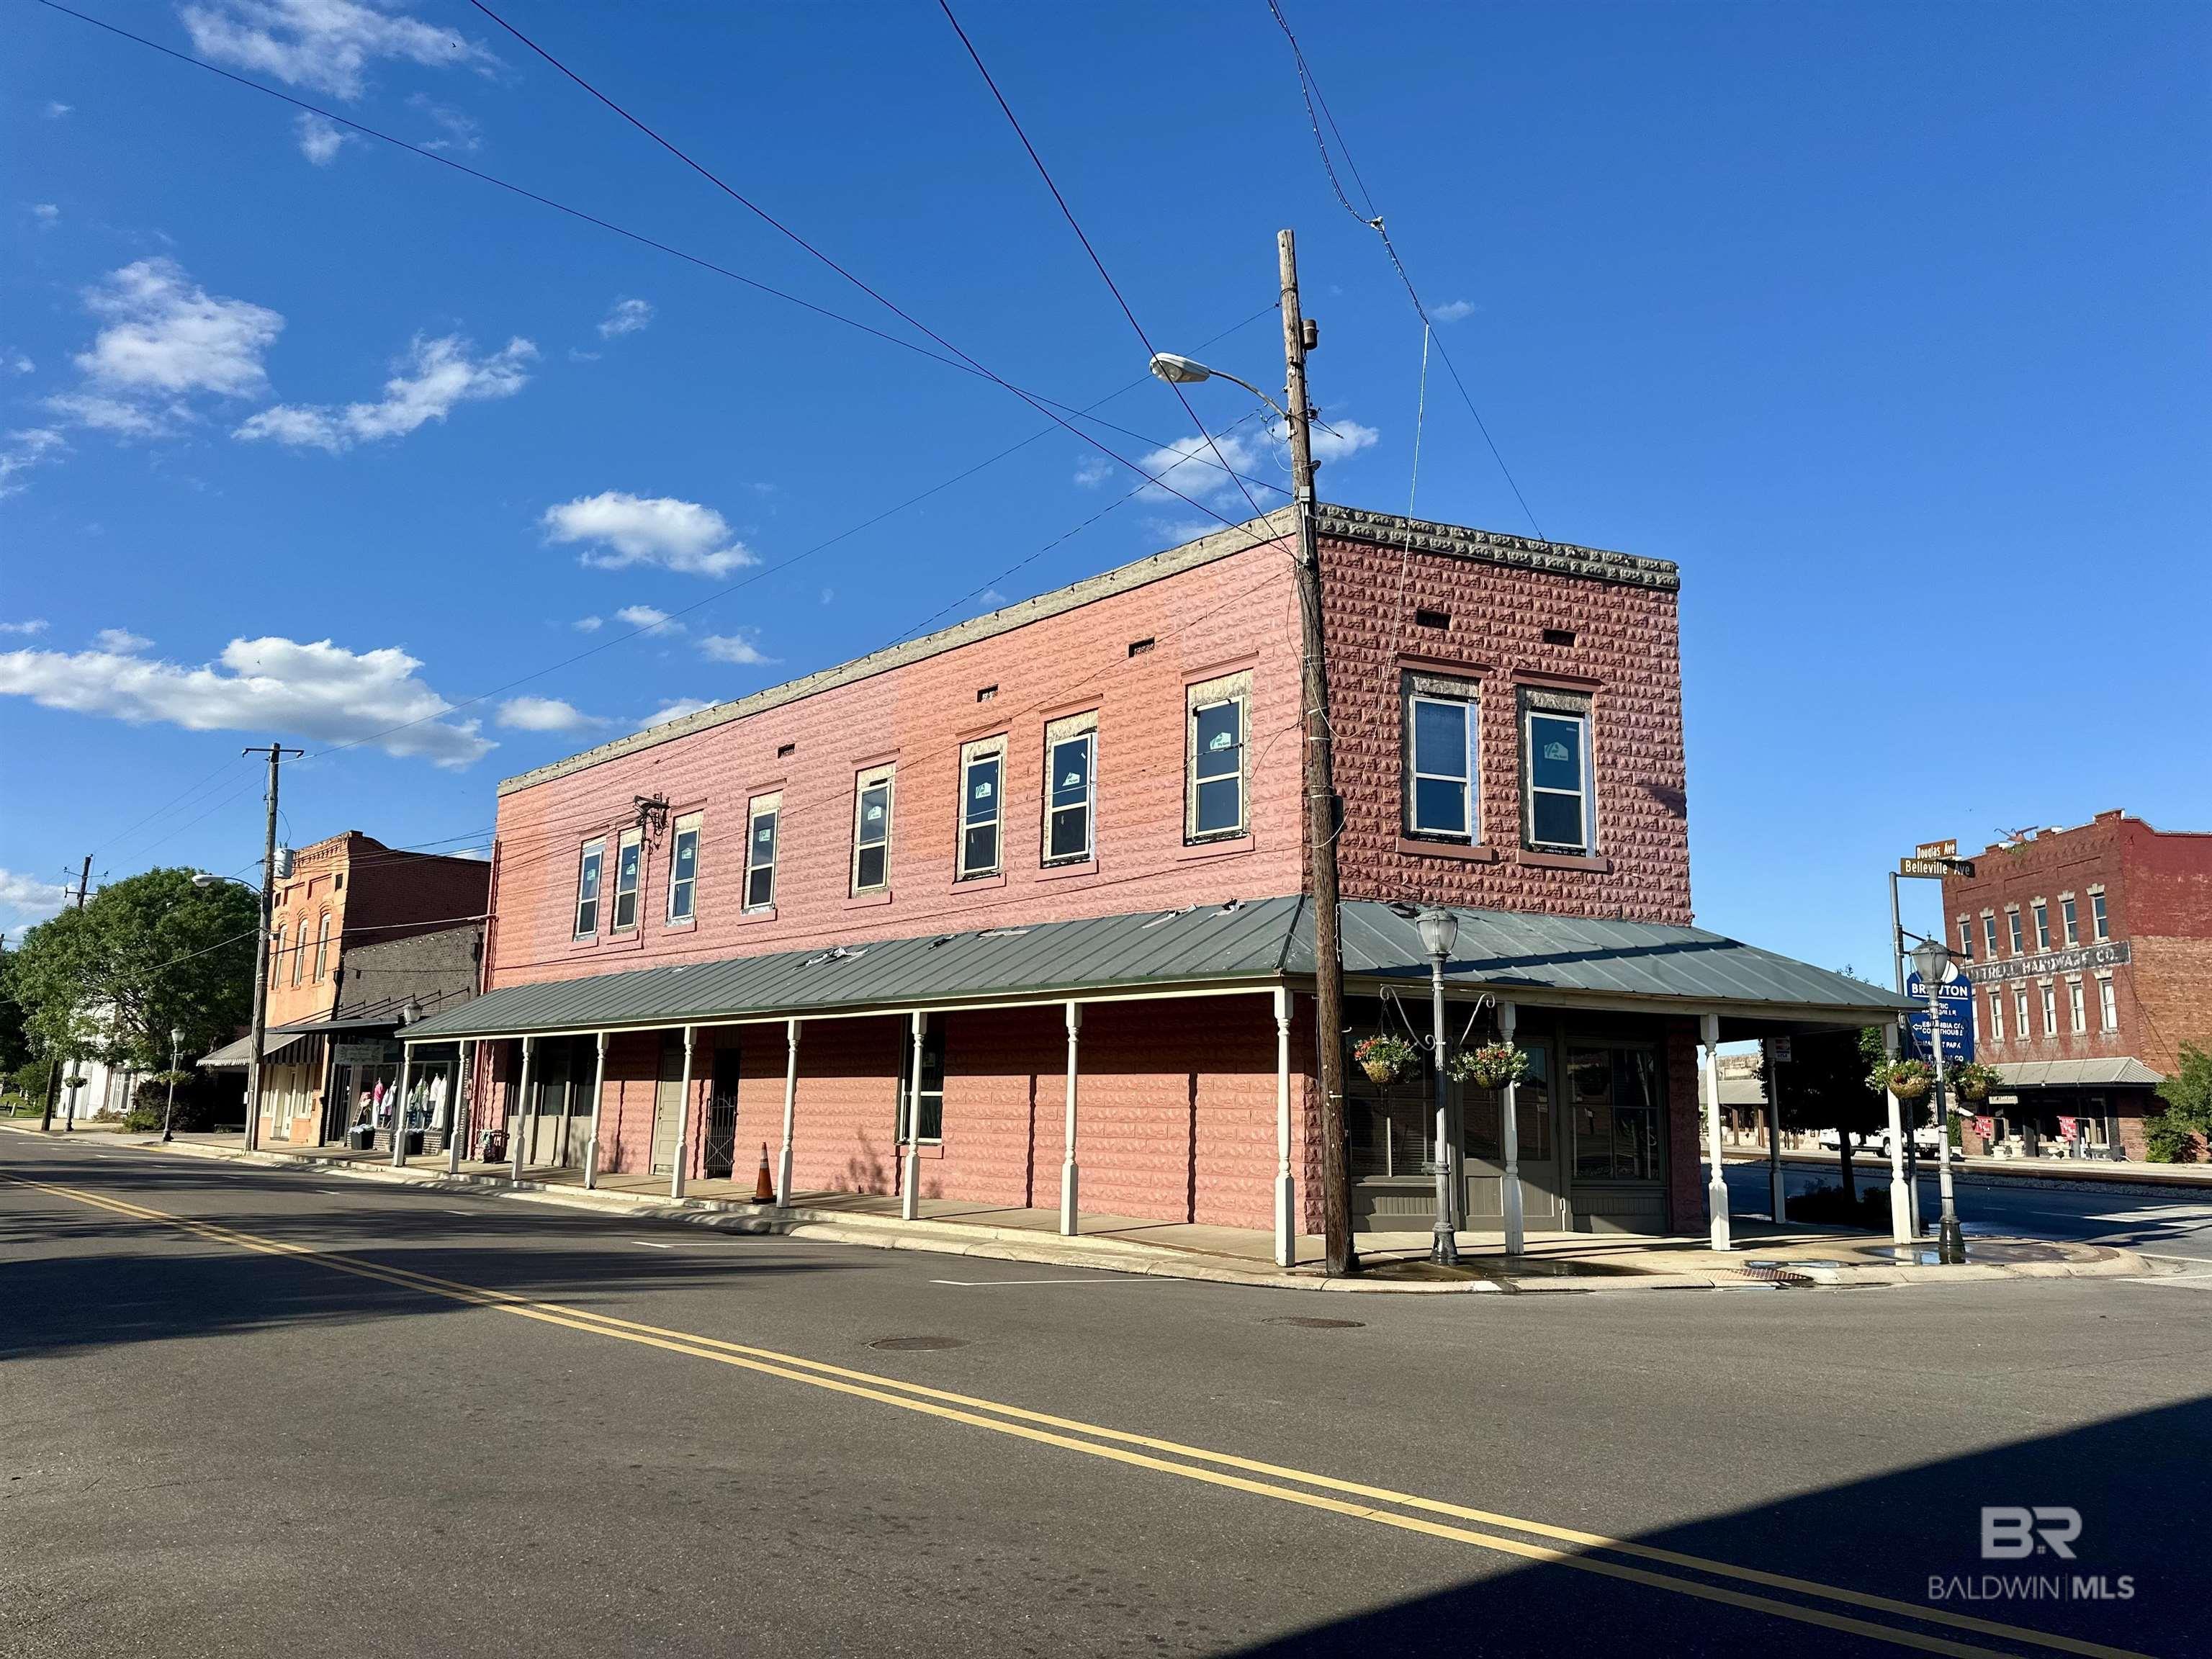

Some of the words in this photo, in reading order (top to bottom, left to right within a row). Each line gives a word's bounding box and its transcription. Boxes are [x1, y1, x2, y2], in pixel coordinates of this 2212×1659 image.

[1917, 845, 1941, 859] Douglas
[1944, 842, 1955, 855] Ave
[1905, 860, 1948, 875] Belleville
[1954, 863, 1970, 875] Ave
[1912, 983, 1968, 997] BRTON
[1922, 1028, 1963, 1036] COTHOUSE
